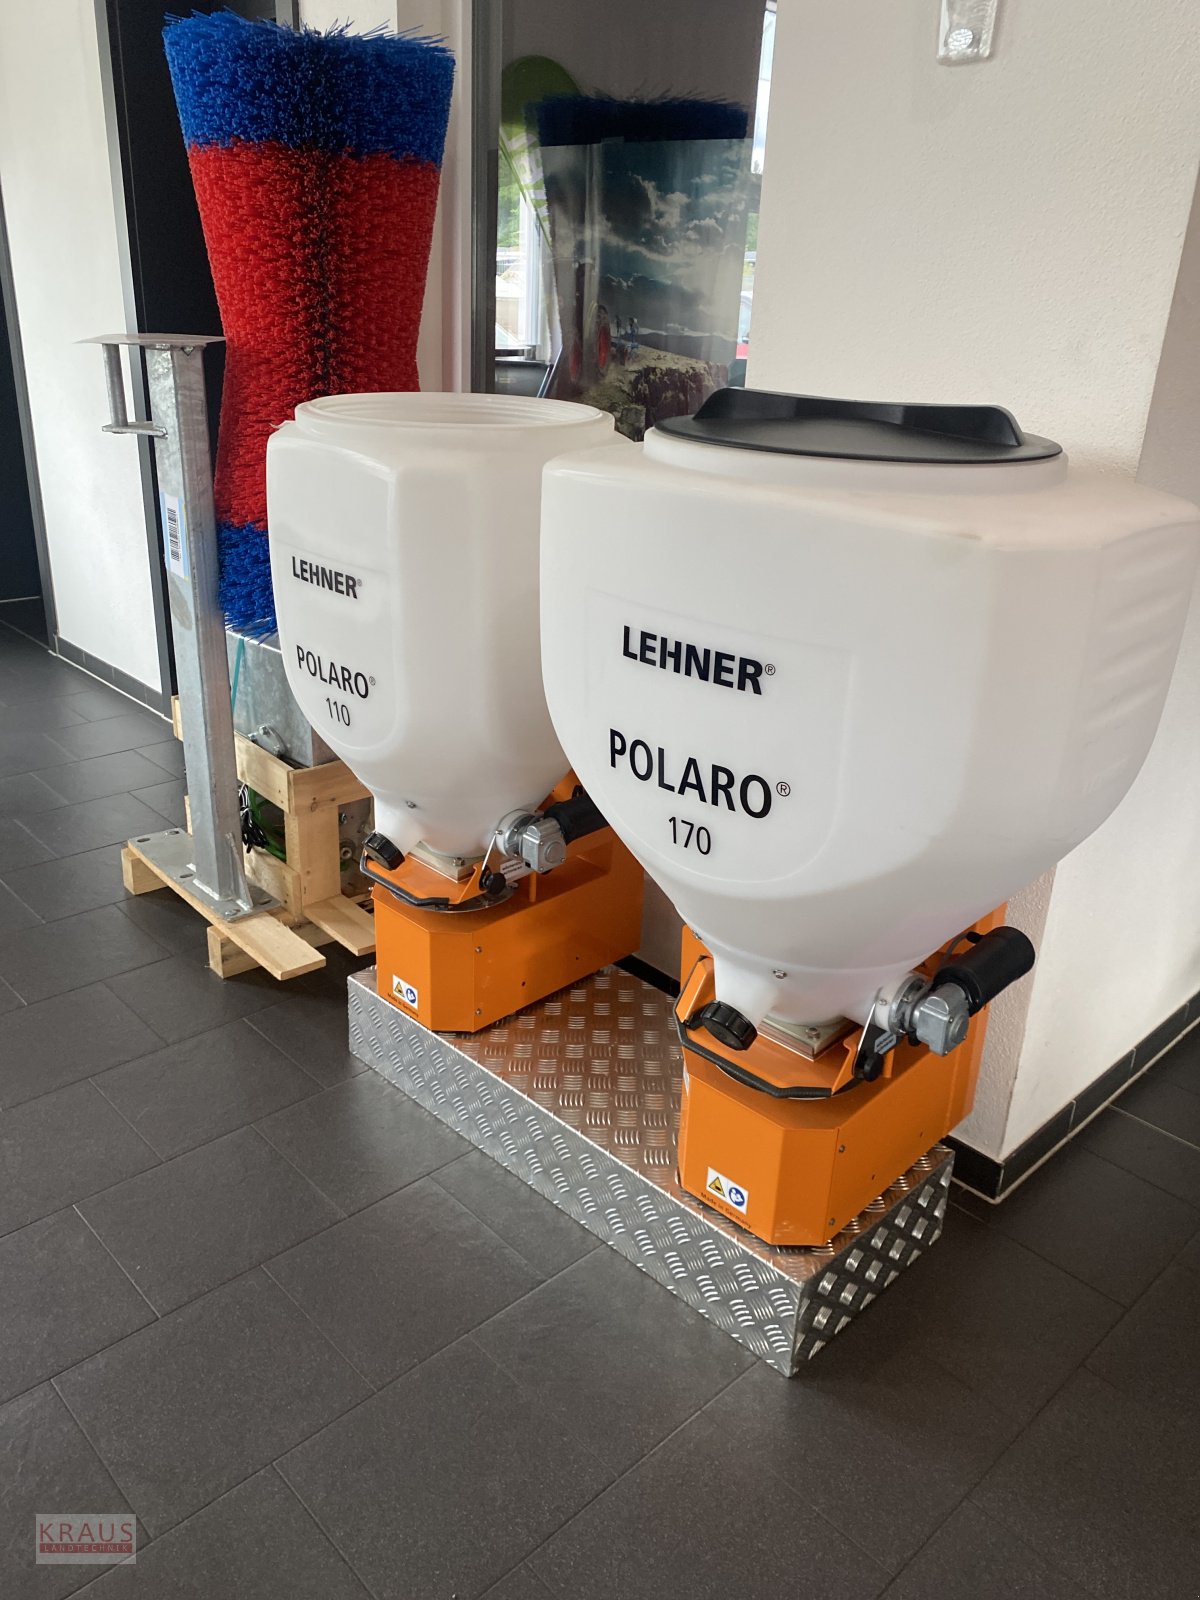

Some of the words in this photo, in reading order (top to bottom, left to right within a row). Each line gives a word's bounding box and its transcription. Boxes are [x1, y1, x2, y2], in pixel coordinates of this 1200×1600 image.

[326, 697, 351, 727] 110
[668, 816, 711, 855] 170
[700, 1191, 717, 1206] Made
